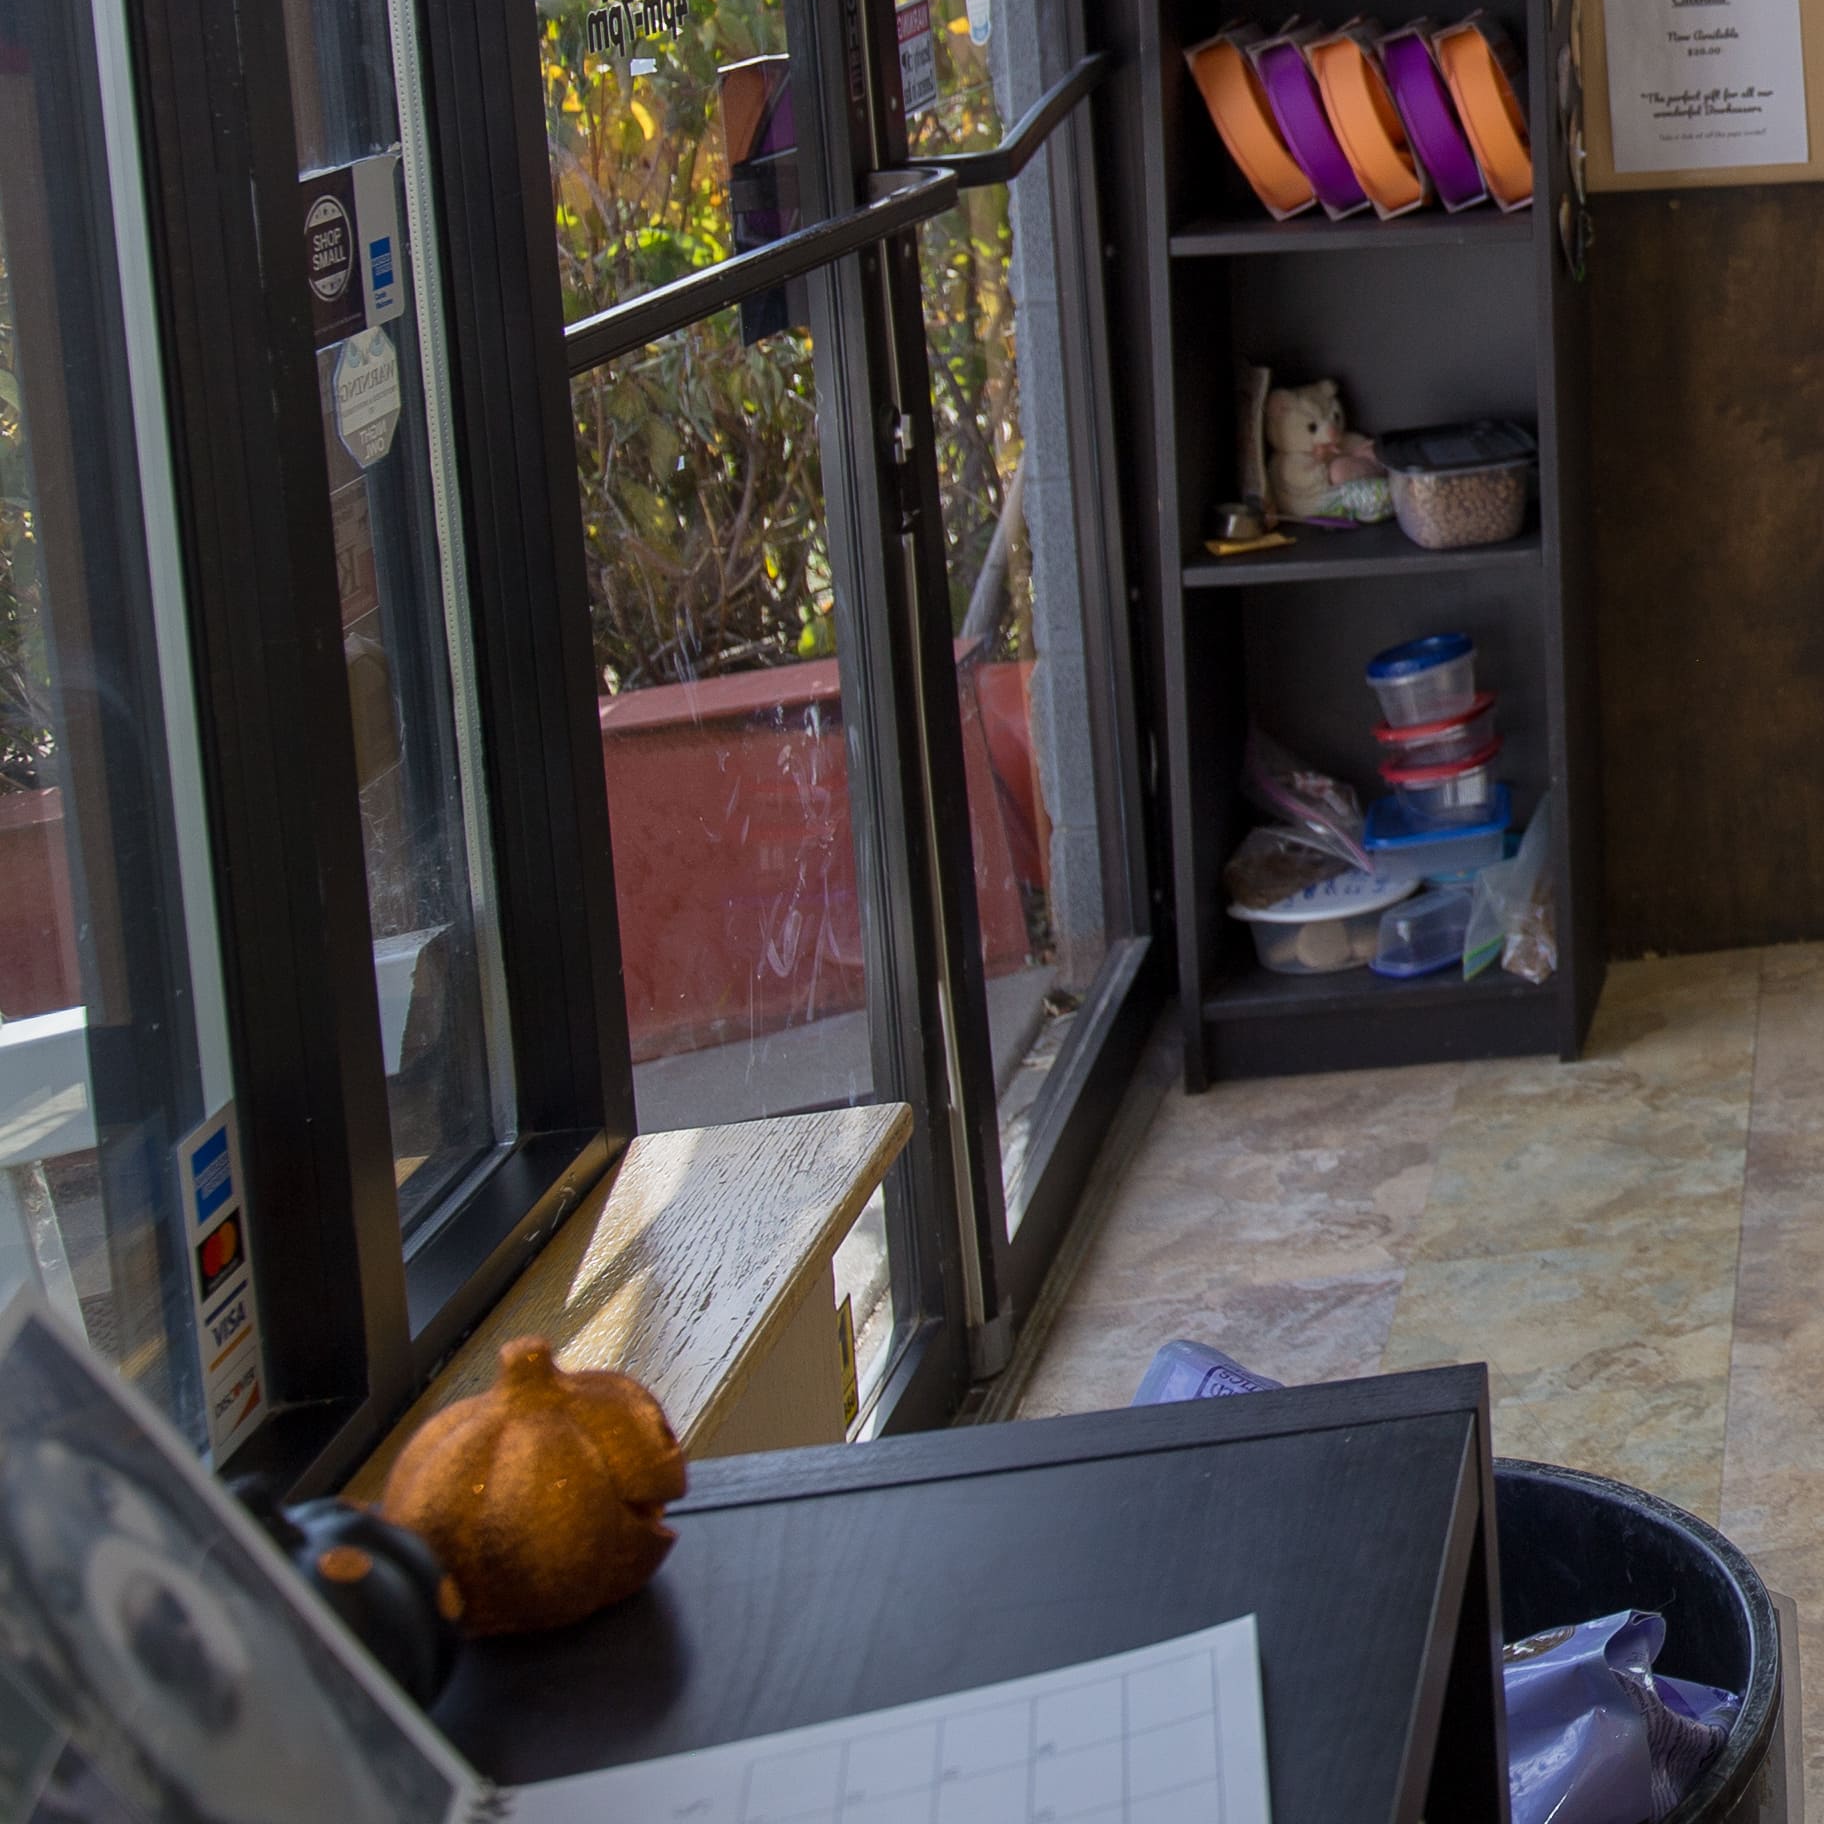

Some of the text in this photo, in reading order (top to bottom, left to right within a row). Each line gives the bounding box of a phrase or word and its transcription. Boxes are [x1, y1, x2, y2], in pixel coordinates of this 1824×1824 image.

[312, 227, 343, 253] SHOP
[312, 249, 347, 272] SMALL
[212, 1301, 248, 1347] VISA
